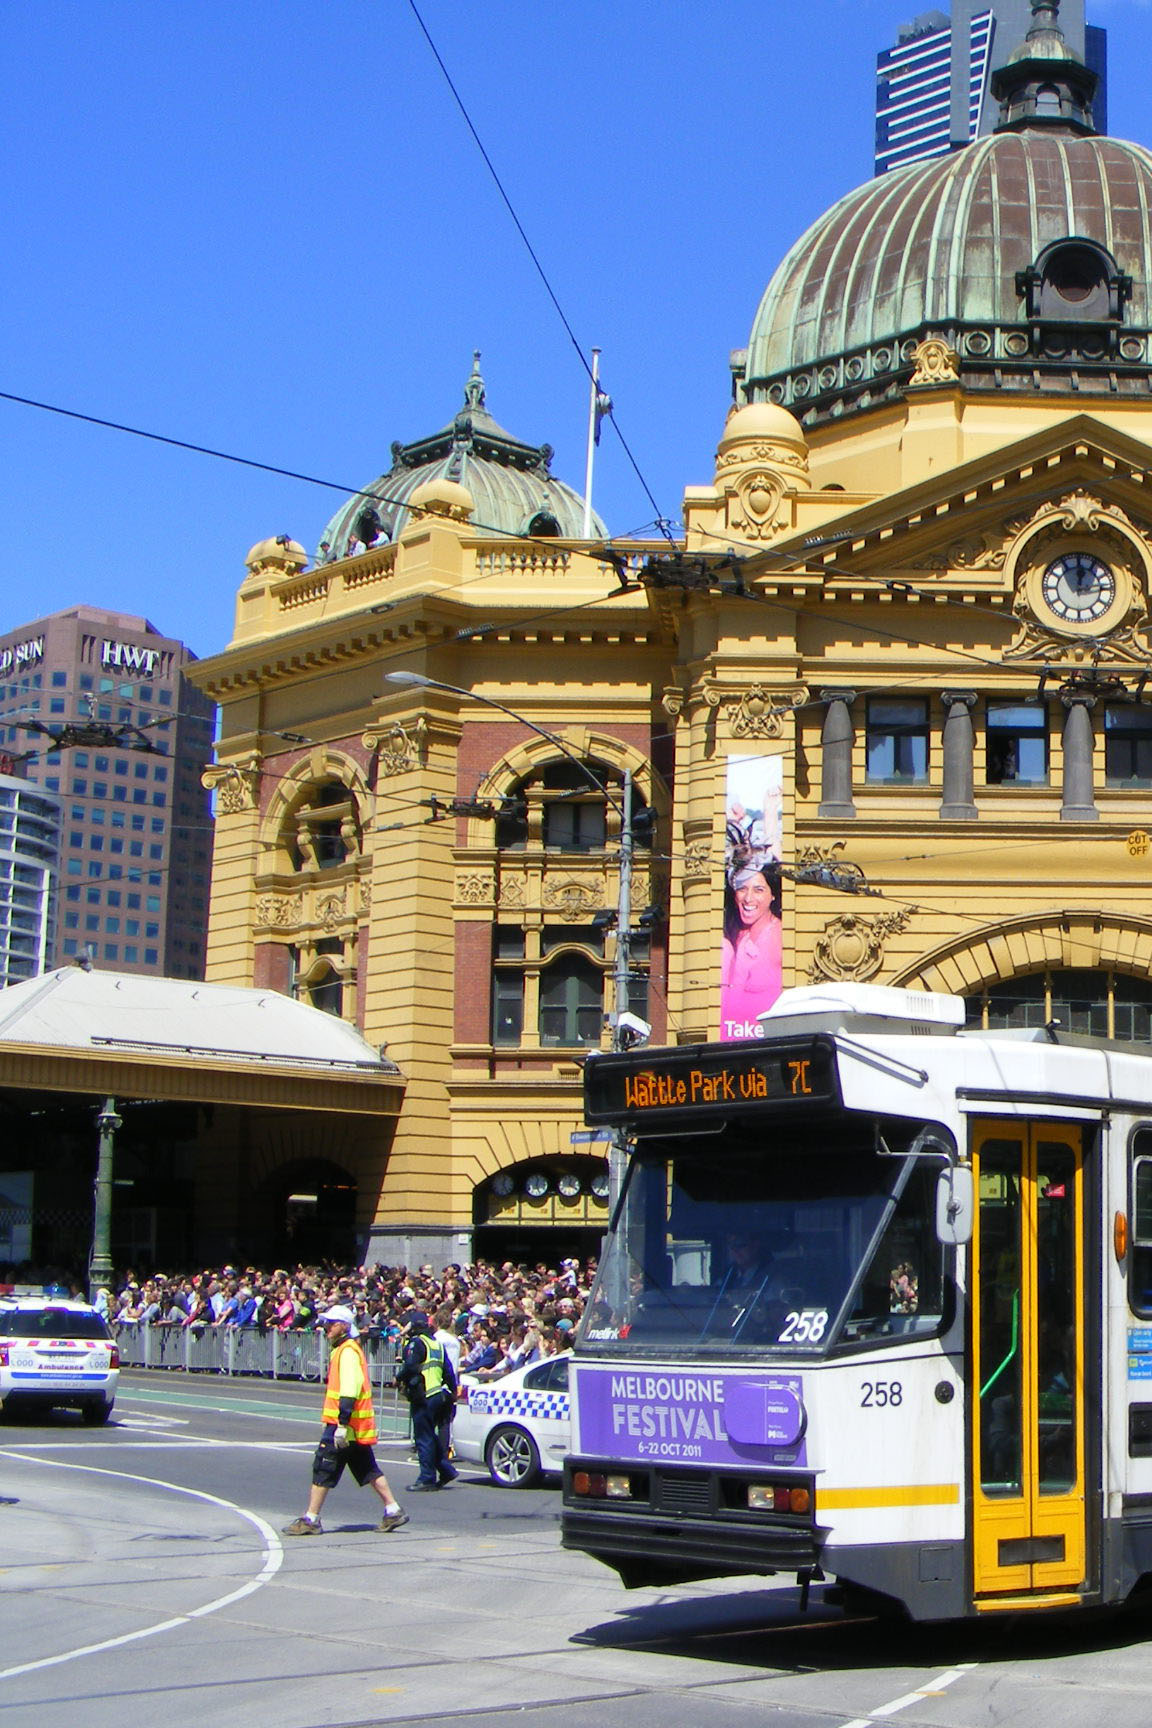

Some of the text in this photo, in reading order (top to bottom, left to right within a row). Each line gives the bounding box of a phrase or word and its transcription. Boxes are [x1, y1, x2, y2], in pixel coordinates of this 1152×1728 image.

[16, 638, 43, 664] SUN
[102, 641, 159, 671] HWT
[1128, 834, 1147, 845] CUT
[1129, 846, 1149, 856] OFF
[723, 1020, 765, 1038] Take
[625, 1067, 768, 1108] Wattle Park via
[778, 1311, 829, 1343] 258
[38, 1363, 85, 1371] Ambulance
[611, 1376, 725, 1403] MELBOURNE
[860, 1381, 903, 1408] 258
[612, 1404, 729, 1442] FESTIVAL
[638, 1441, 702, 1458] 6-22 OCT 2011
